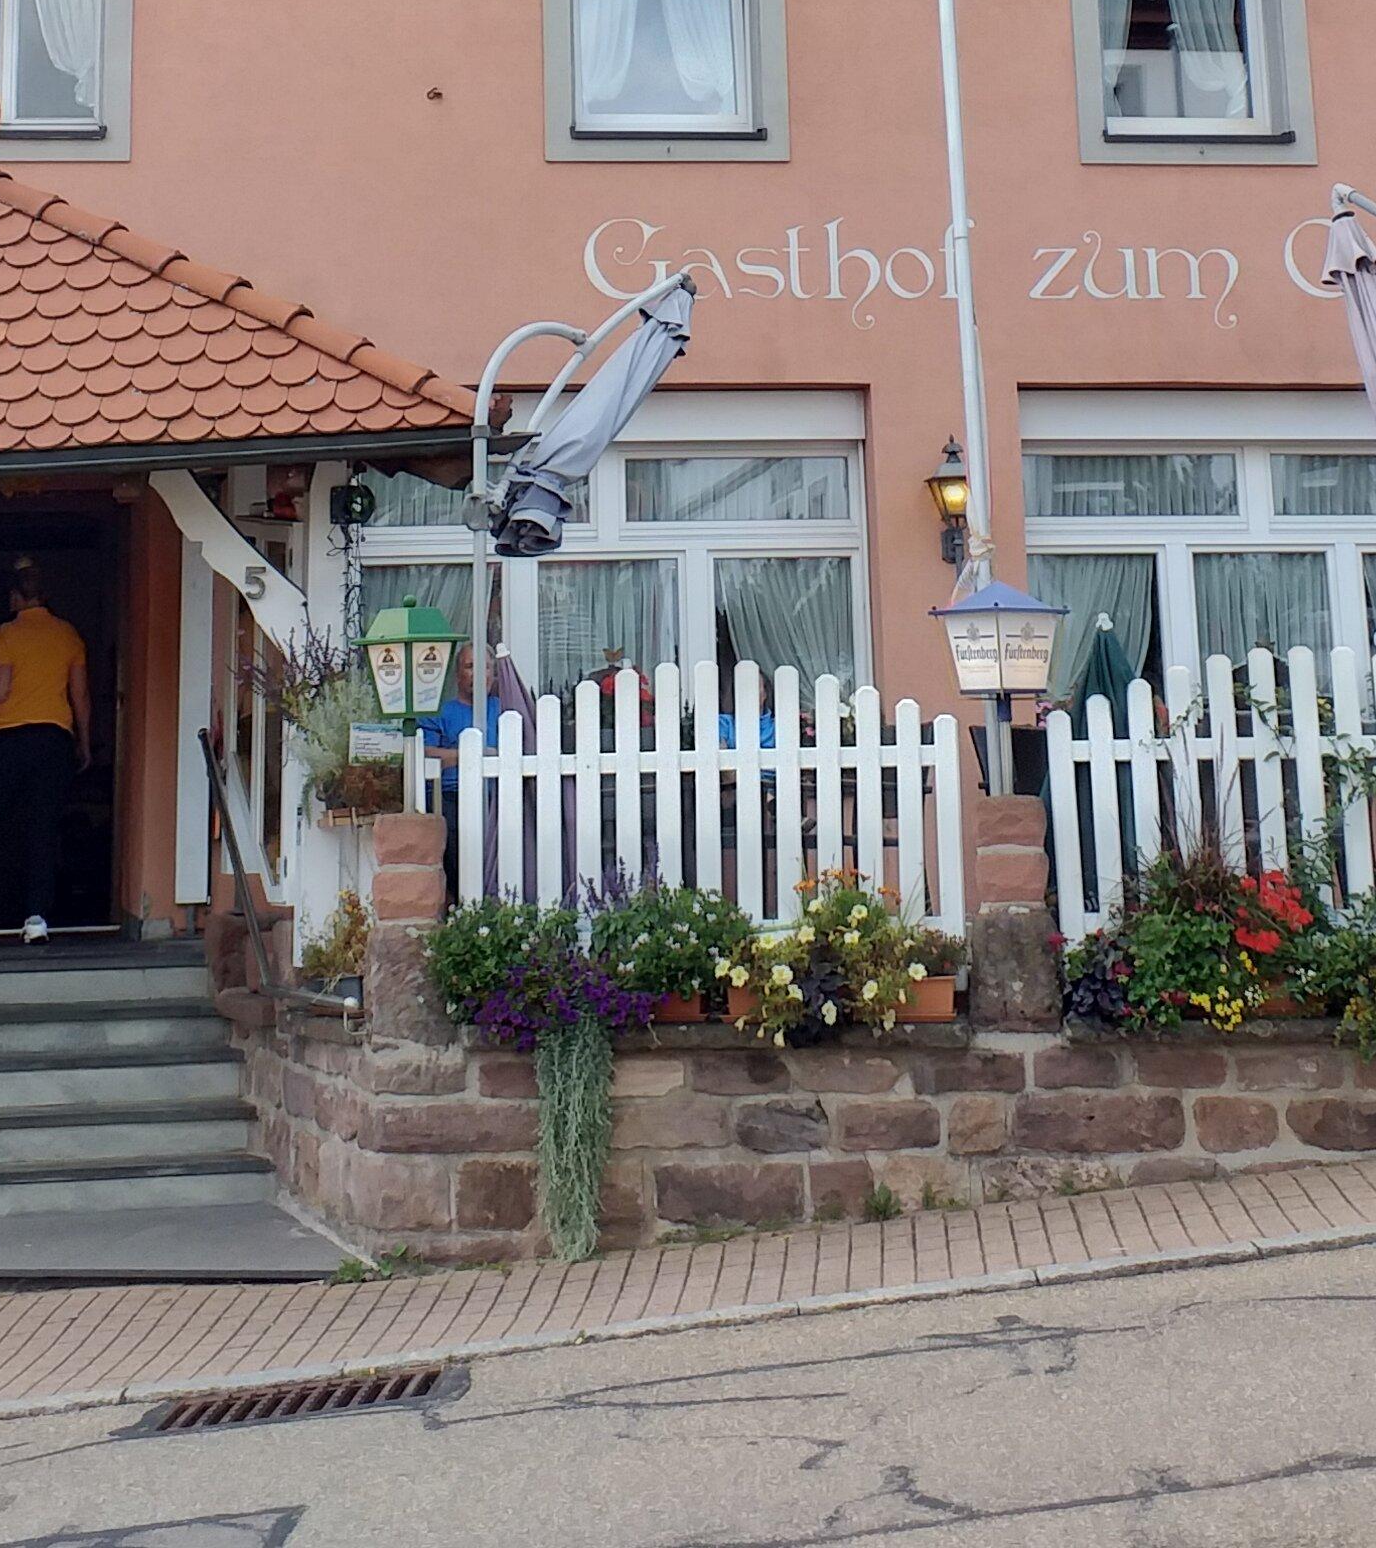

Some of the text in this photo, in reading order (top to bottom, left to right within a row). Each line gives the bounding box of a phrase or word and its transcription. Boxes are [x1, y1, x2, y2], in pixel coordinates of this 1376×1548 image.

[583, 216, 976, 330] Gasthof
[1028, 230, 1239, 329] zum
[245, 566, 266, 600] 5
